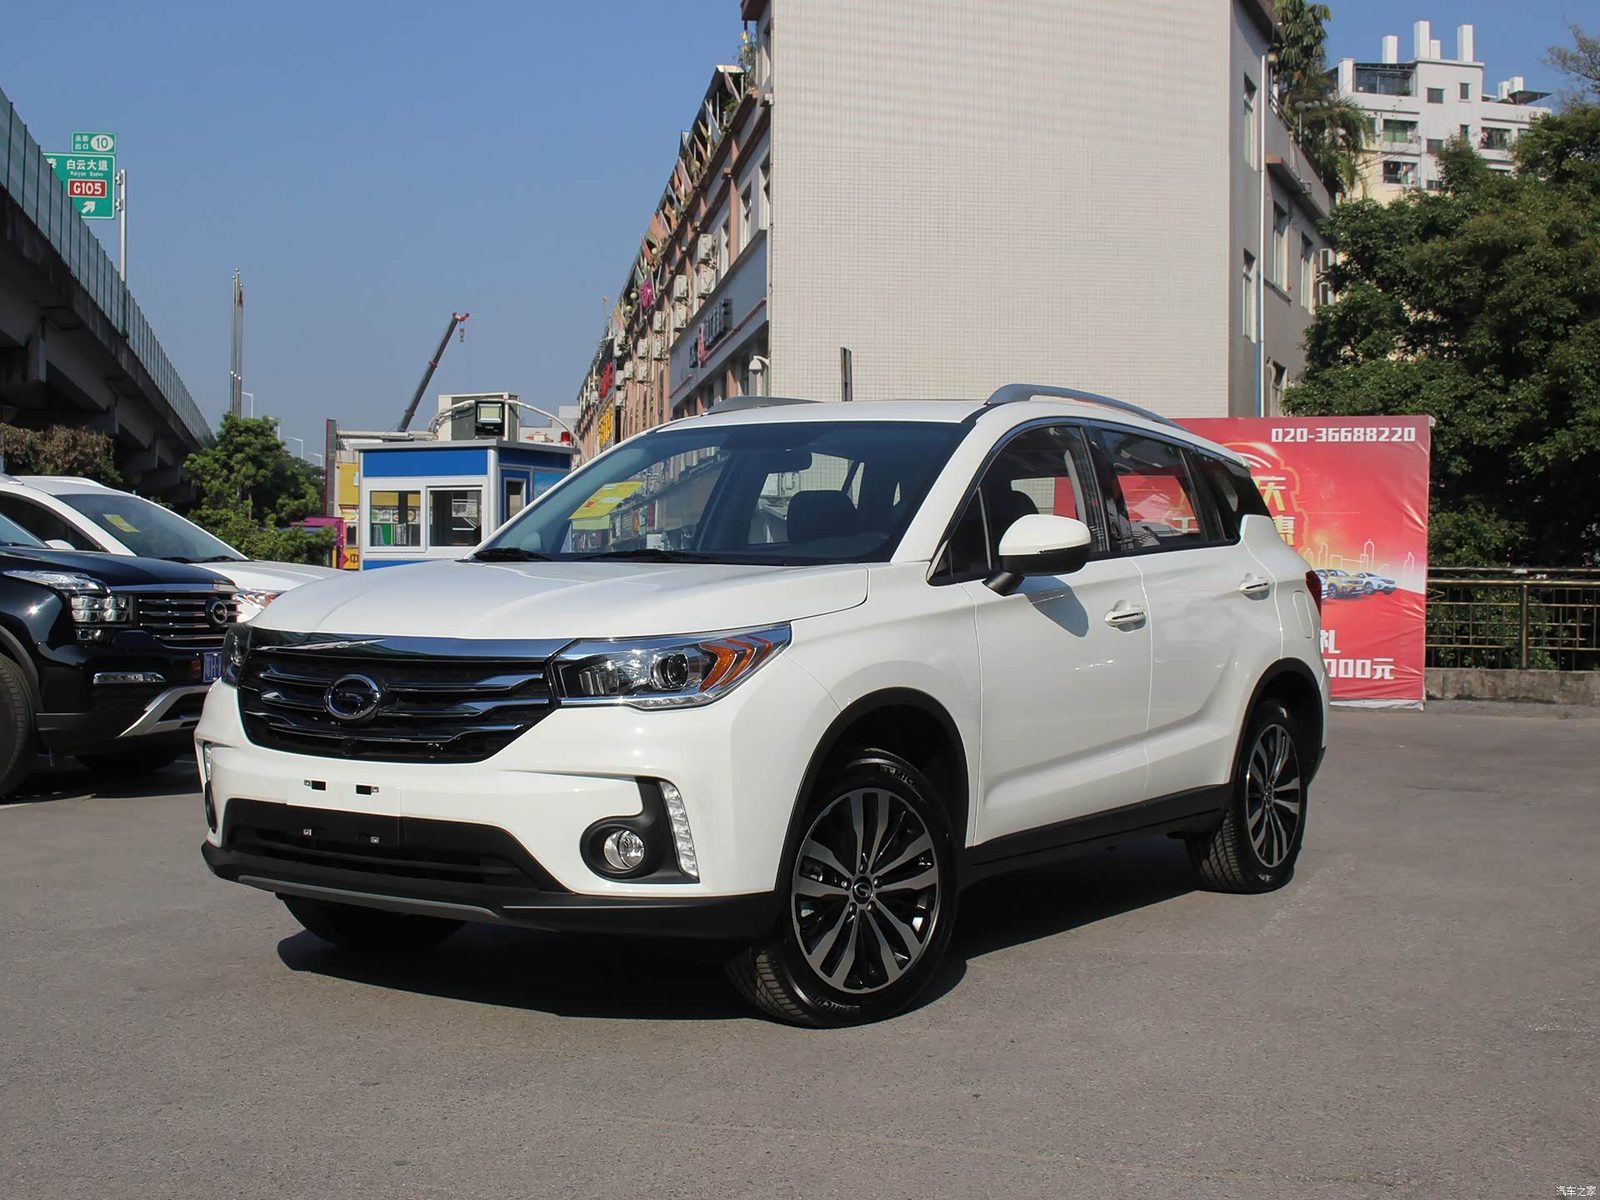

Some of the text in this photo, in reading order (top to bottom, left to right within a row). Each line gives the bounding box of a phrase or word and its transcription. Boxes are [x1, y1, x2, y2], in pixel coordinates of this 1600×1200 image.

[96, 137, 109, 149] 10
[66, 159, 108, 171] 白云大道
[73, 182, 102, 195] G105
[1271, 426, 1416, 443] 020-36688220
